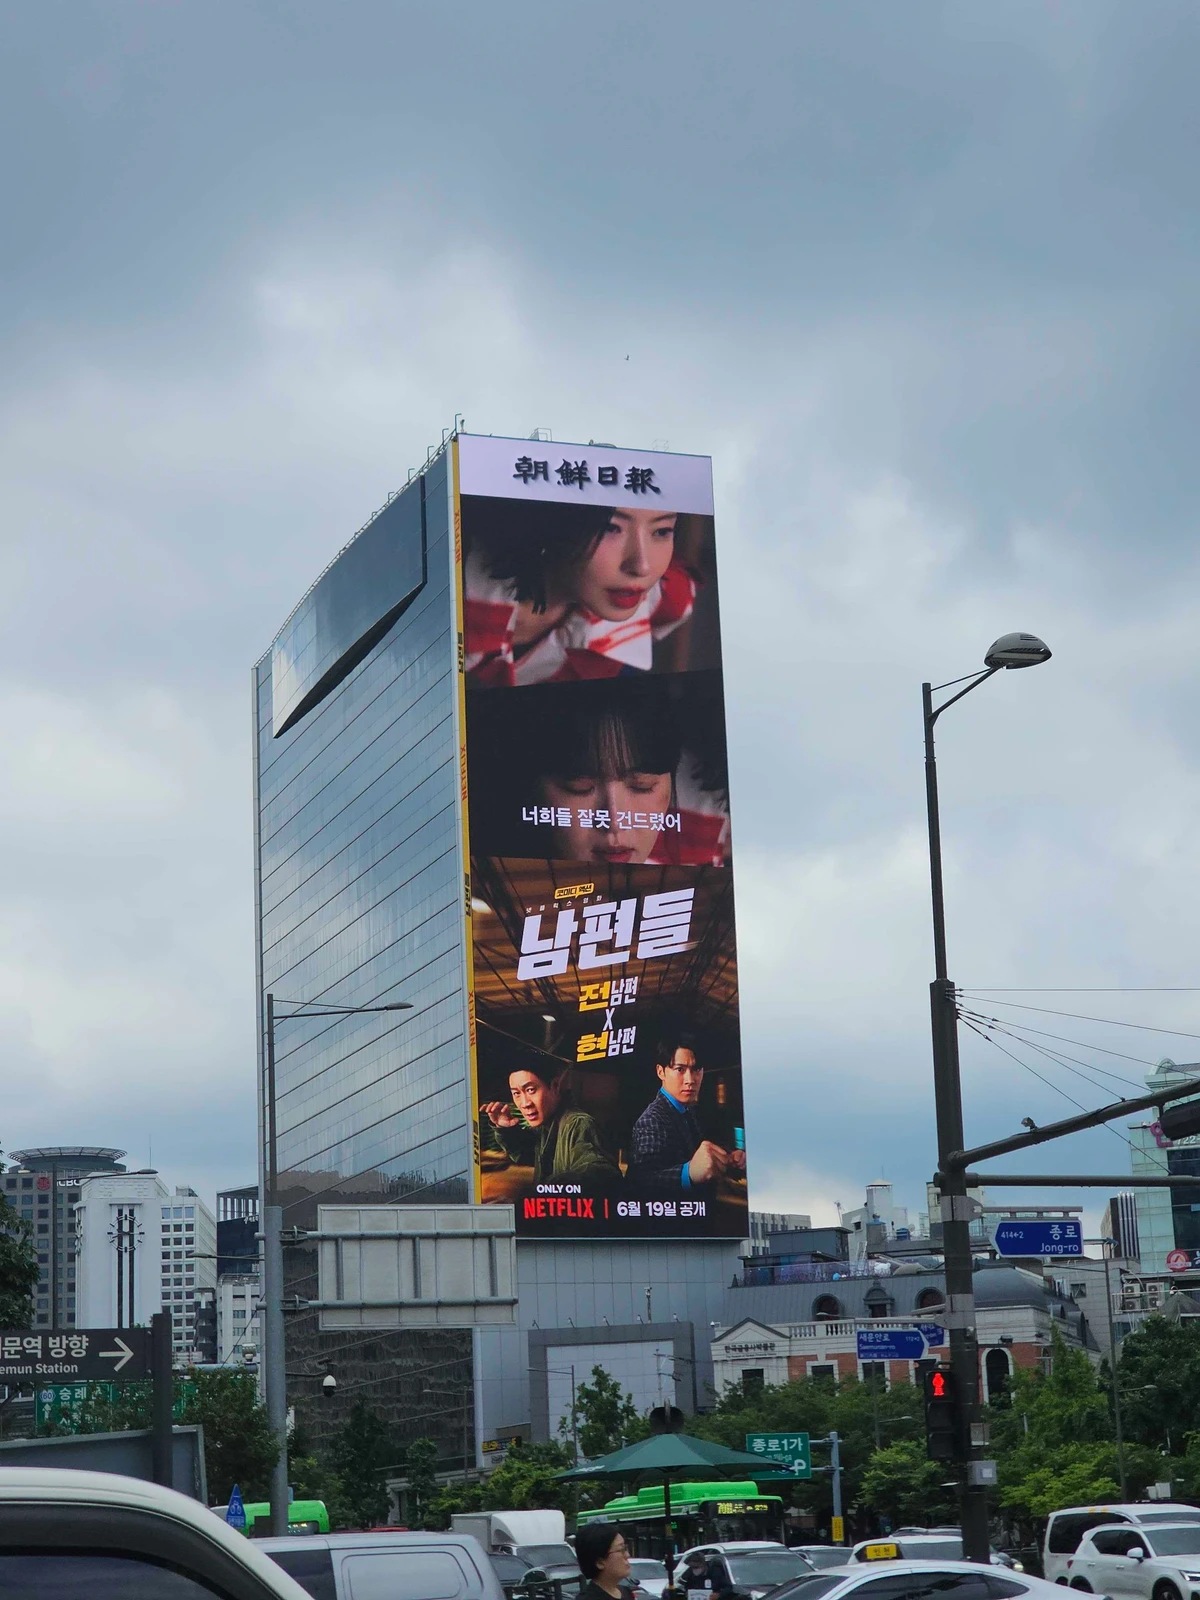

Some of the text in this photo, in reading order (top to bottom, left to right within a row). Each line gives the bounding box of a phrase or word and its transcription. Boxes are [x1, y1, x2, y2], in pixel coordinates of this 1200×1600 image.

[513, 456, 661, 494] 朝鮮日報
[522, 805, 681, 832] 너희들 잘못 건드렸어
[516, 887, 695, 981] 남편들
[579, 976, 639, 1012] 전남편
[576, 1026, 637, 1062] 현남편
[536, 1184, 581, 1193] ONLY ON
[523, 1198, 594, 1219] NETFLIX
[616, 1201, 706, 1217] 6월 19일 공개
[1049, 1224, 1078, 1240] 종로
[1040, 1242, 1079, 1253] Jong-ro
[0, 1334, 89, 1359] 문역 방향
[36, 1362, 78, 1374] Station
[752, 1438, 803, 1452] 종로1가
